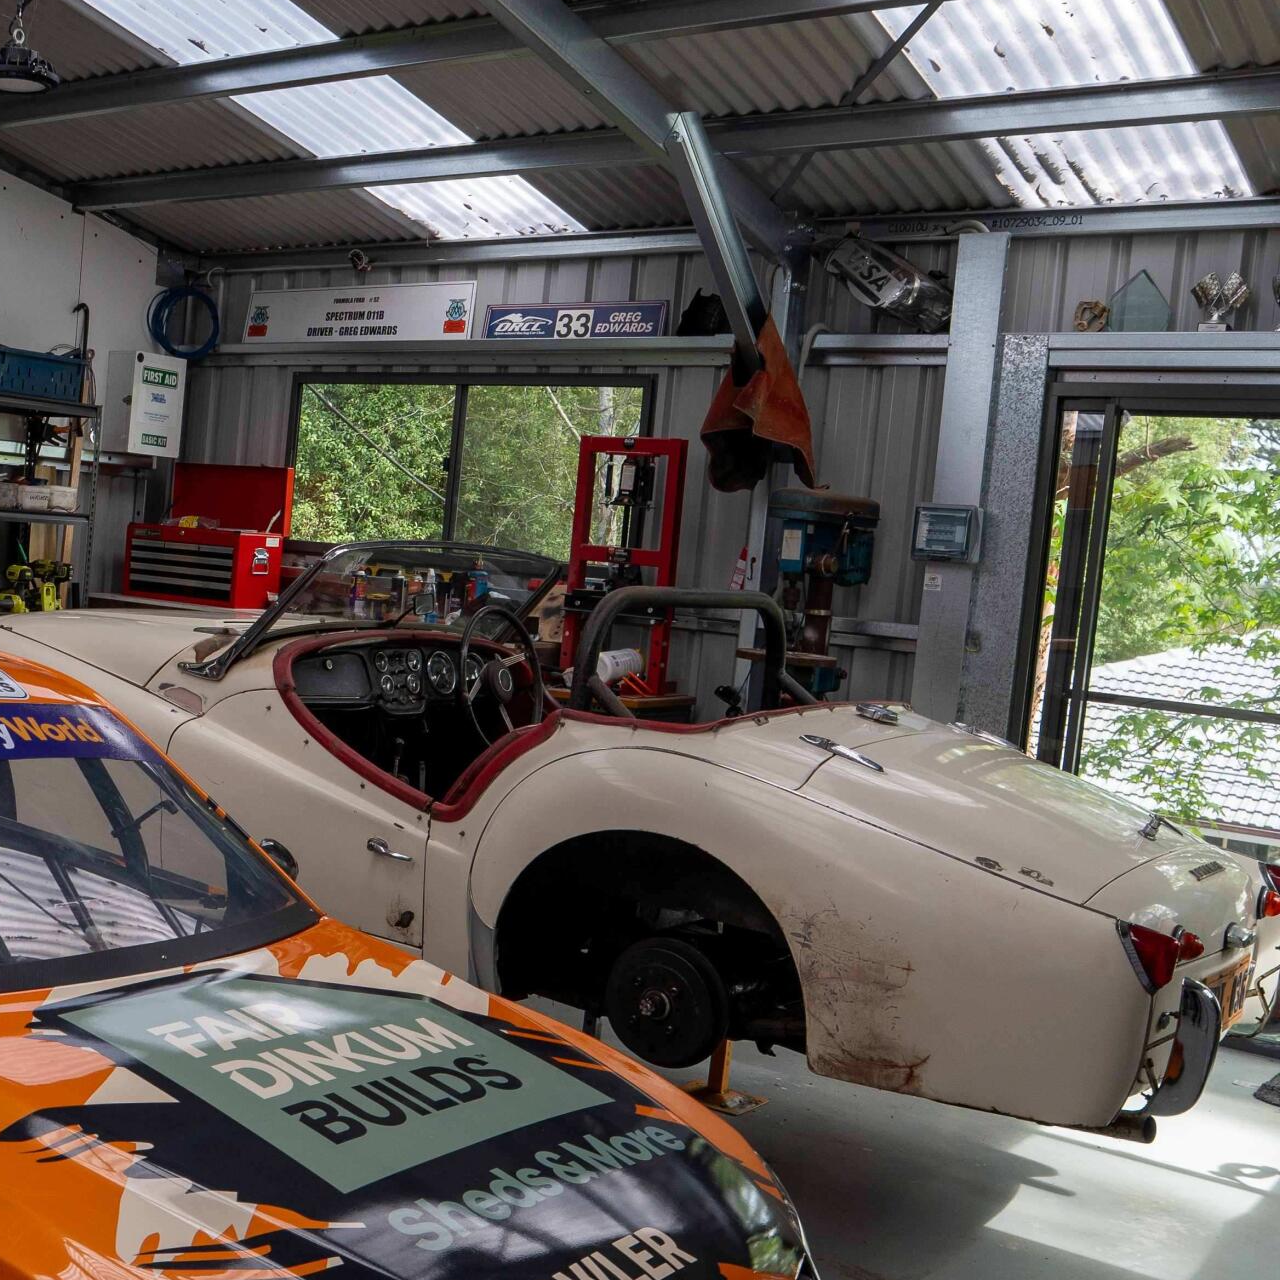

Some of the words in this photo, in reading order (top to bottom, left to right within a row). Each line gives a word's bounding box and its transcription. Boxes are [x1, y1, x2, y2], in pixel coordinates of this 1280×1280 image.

[325, 310, 366, 322] SPECTRUM
[609, 311, 642, 322] GREG
[307, 326, 333, 337] DRIVER
[338, 326, 359, 337] GREG
[359, 325, 398, 336] EDWARDS
[555, 312, 592, 338] 33
[594, 322, 654, 334] EDWARDS
[143, 369, 164, 383] FIRST
[164, 372, 177, 386] AID
[148, 1000, 325, 1059] FAIR
[211, 1016, 478, 1101] DINKUM
[280, 1055, 525, 1146] BUILDS
